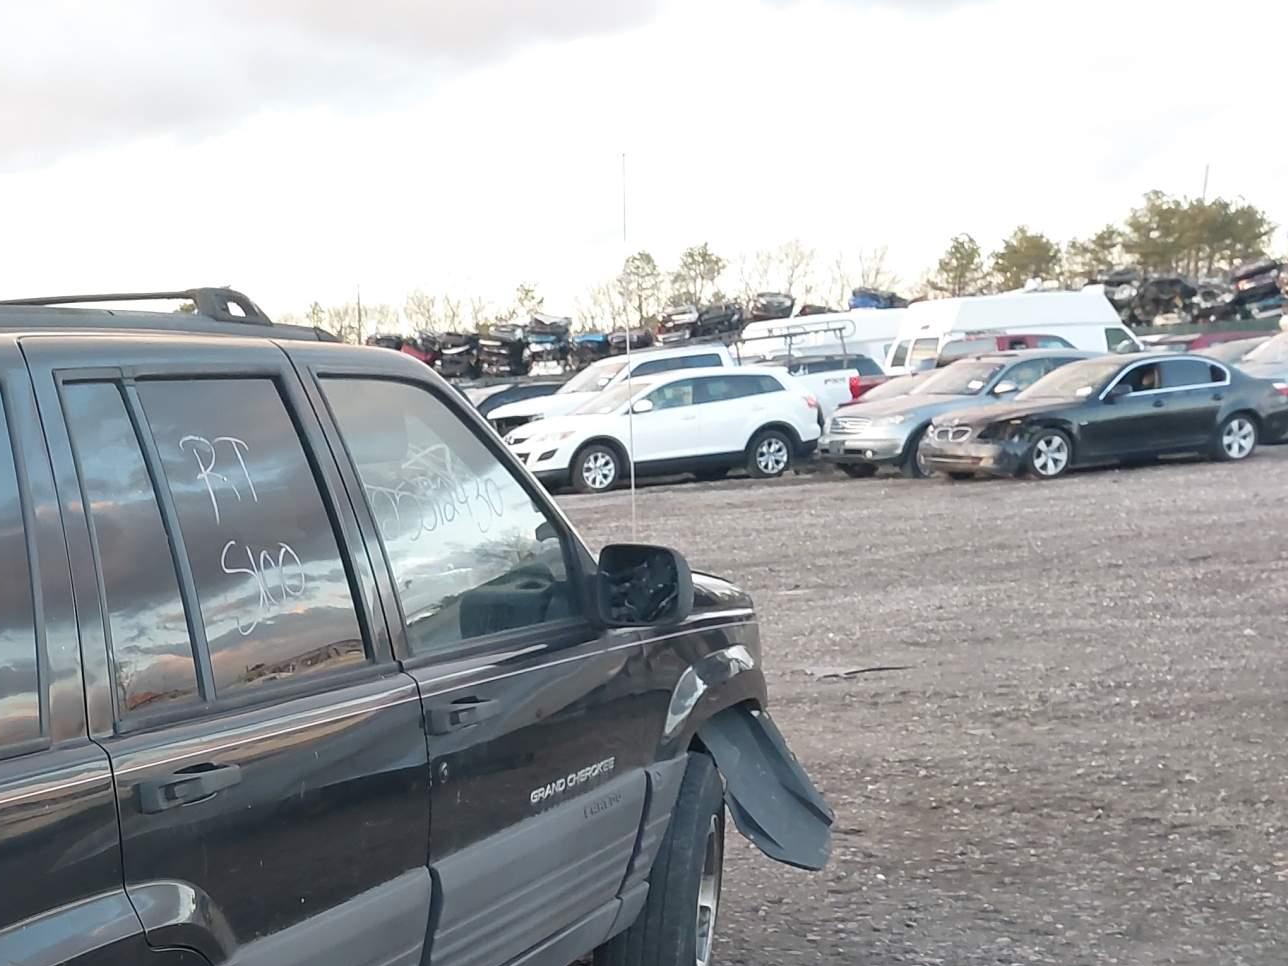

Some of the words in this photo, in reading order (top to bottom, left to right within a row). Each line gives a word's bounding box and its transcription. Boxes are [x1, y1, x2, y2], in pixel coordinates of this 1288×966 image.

[179, 435, 258, 525] RT
[530, 778, 566, 804] GRAND
[566, 757, 616, 788] CHEROKEE
